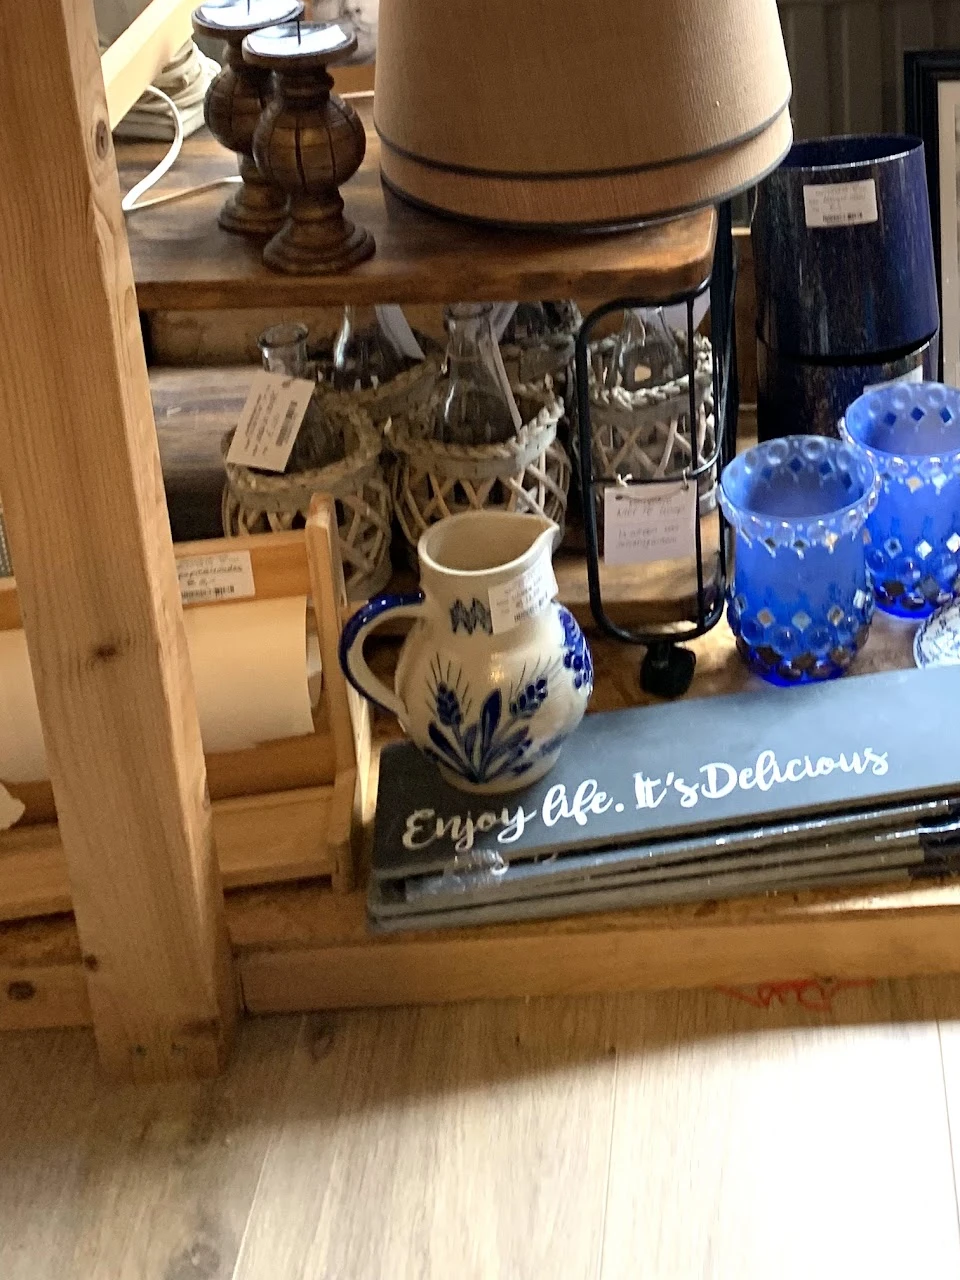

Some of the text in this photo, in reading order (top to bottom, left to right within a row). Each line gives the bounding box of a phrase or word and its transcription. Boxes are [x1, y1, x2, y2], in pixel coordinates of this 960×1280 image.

[402, 804, 538, 853] Enjoy
[541, 778, 625, 827] life.
[700, 747, 890, 799] Delicious
